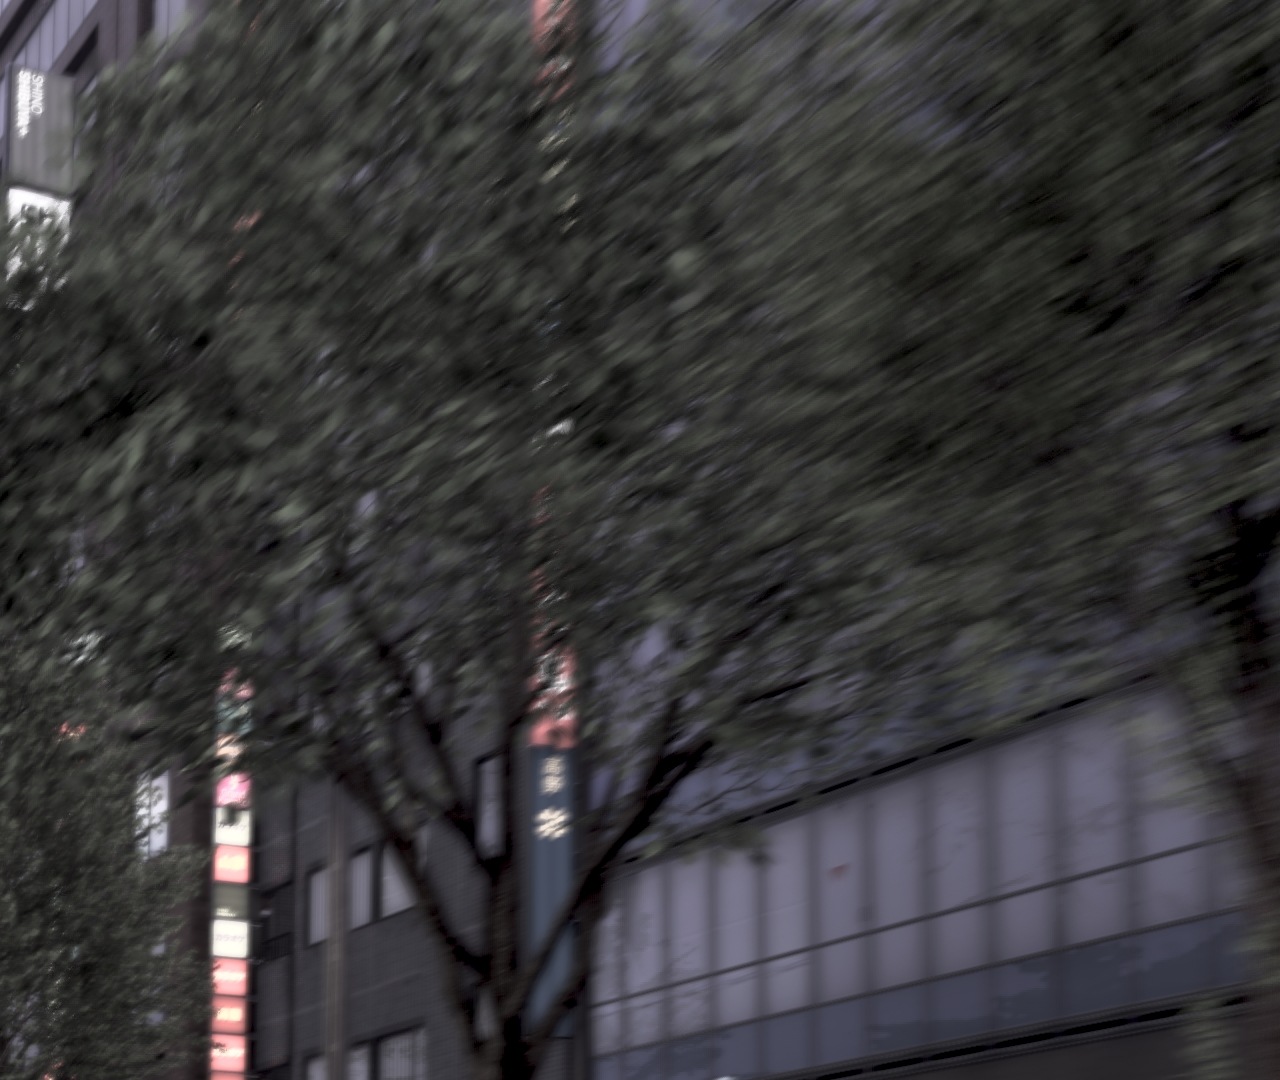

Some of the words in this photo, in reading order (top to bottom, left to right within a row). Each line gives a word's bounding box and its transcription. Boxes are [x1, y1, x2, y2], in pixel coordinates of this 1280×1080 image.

[31, 73, 44, 115] SHINO
[215, 933, 245, 943] カラオケ
